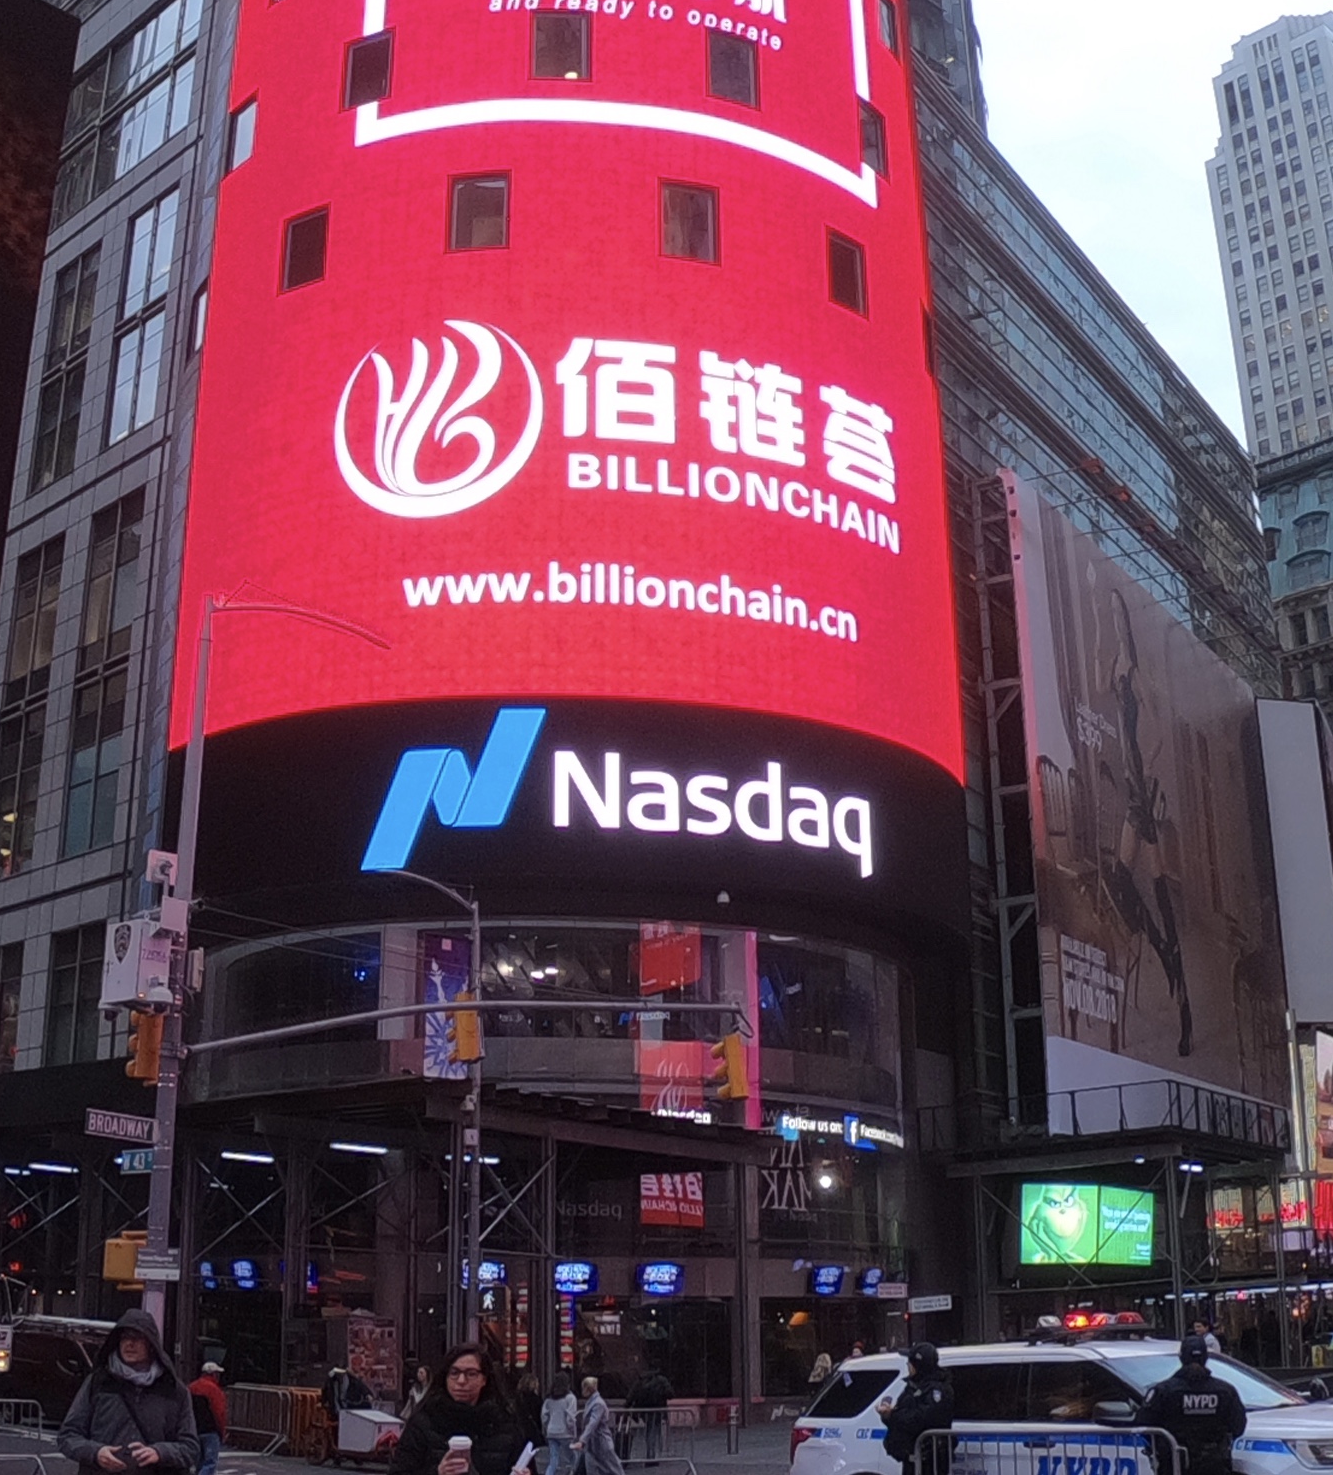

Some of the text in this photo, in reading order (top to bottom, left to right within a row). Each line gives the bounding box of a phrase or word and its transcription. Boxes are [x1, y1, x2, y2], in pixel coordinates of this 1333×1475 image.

[648, 0, 674, 21] to
[555, 336, 898, 504] 佰链荟
[566, 452, 901, 554] BILLIONCHAIN
[402, 561, 859, 643] www.billionchain.cn
[553, 749, 874, 879] Nasdaq
[87, 1112, 151, 1141] BROADWAY
[781, 1115, 816, 1132] Follow
[133, 1152, 146, 1170] 43
[1183, 1393, 1218, 1410] NYPD
